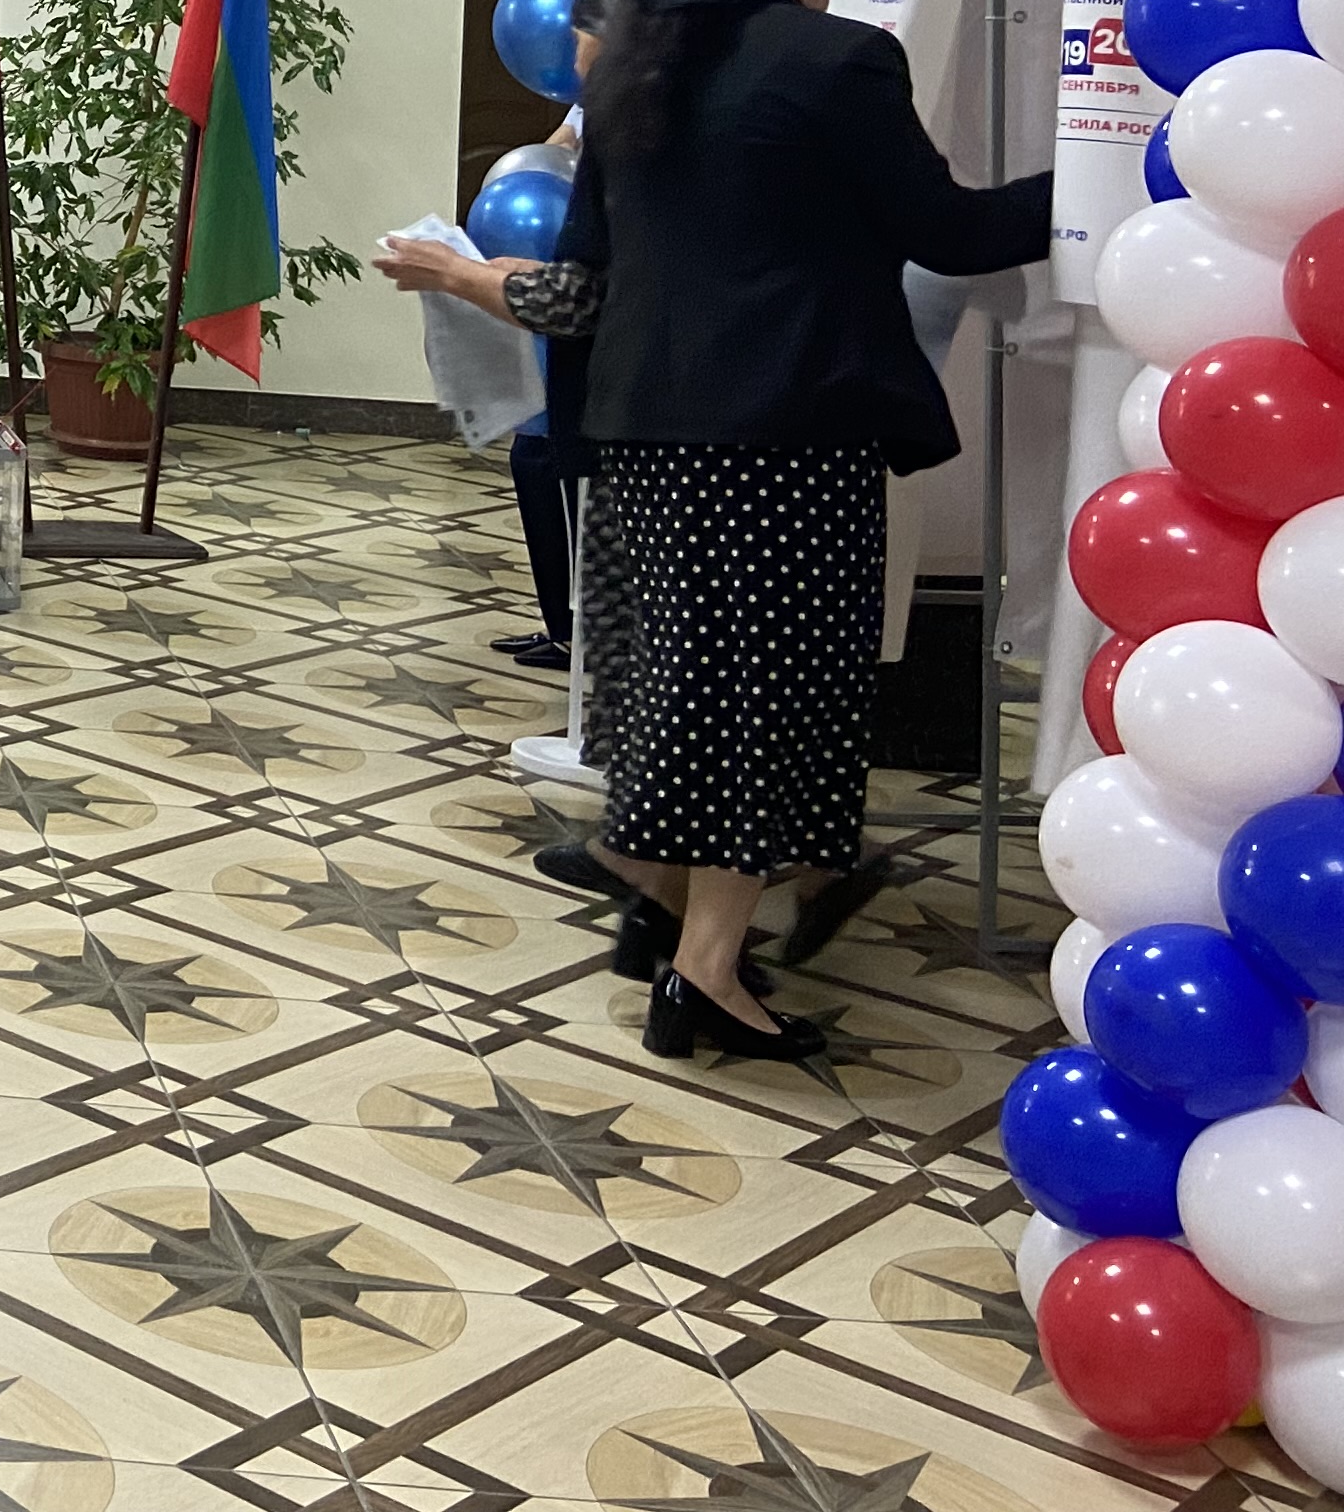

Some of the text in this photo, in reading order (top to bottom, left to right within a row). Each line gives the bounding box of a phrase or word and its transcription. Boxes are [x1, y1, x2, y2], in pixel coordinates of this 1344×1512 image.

[1063, 40, 1086, 66] 19
[1062, 80, 1140, 95] СЕНТЯБРЯ
[1069, 118, 1112, 132] СИЛА
